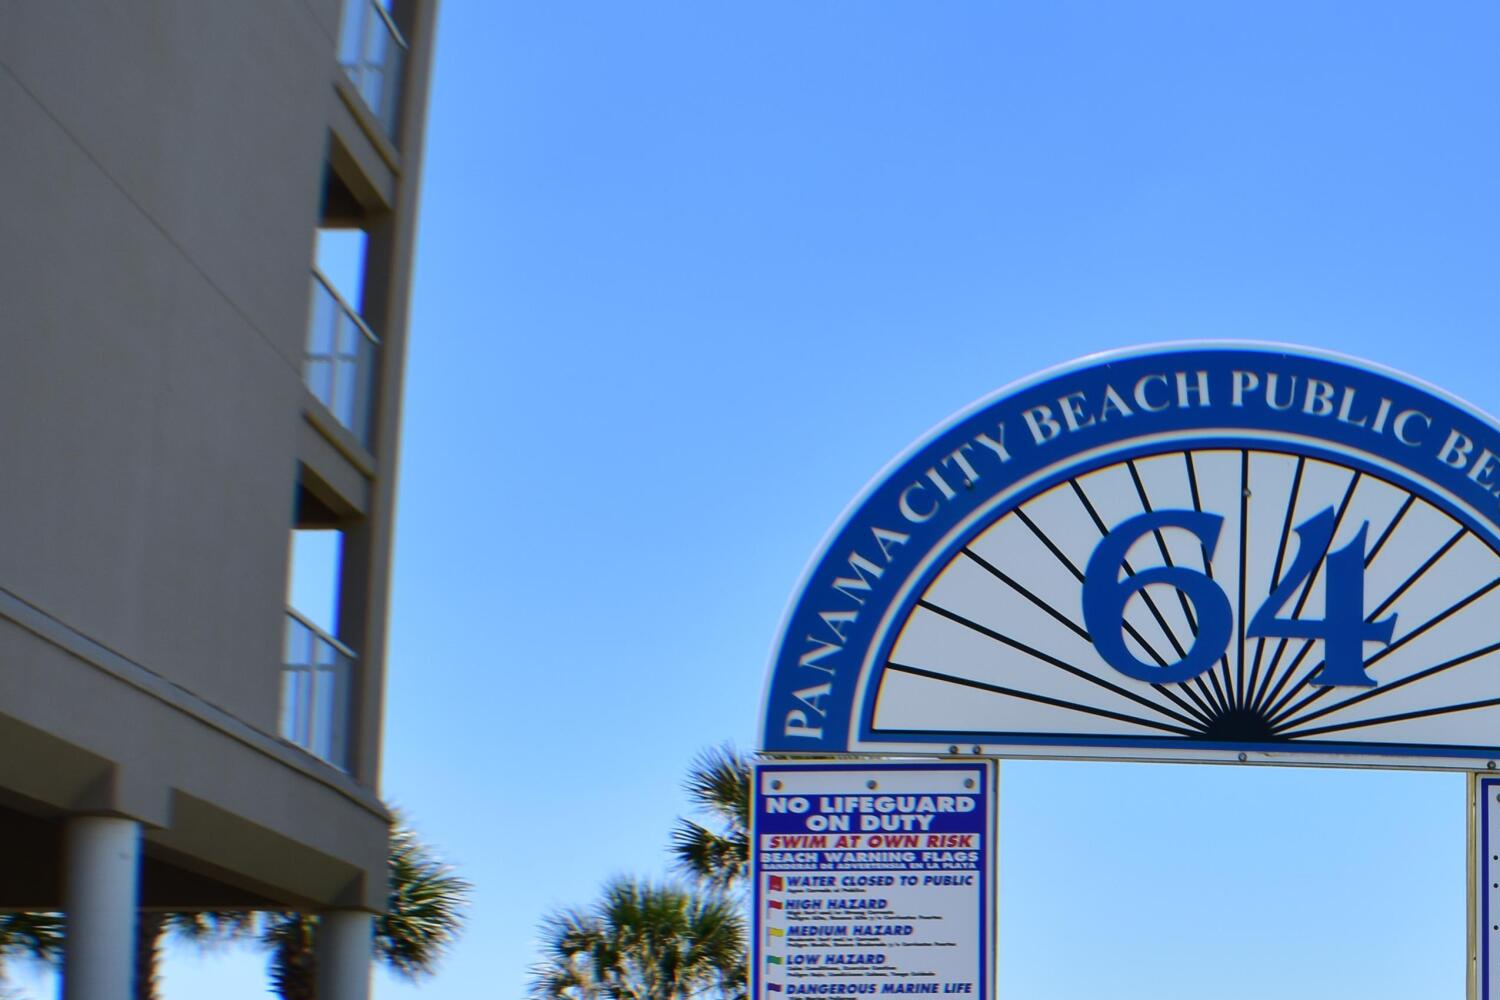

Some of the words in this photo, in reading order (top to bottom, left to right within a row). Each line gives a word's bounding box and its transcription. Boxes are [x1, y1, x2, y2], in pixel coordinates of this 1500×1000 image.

[784, 526, 910, 740] PANAMA
[898, 423, 1012, 523] CITY
[1021, 371, 1211, 446] BEACH
[1232, 370, 1432, 447] PUBLIC
[1081, 504, 1399, 687] 64
[766, 797, 810, 813] NO
[820, 796, 975, 813] LIFEGUARD
[806, 815, 850, 831] ON
[860, 815, 934, 831] DUTY
[769, 835, 826, 848] SWIM
[834, 835, 861, 848] AT
[867, 835, 919, 848] OWN
[926, 835, 972, 848] RISK
[760, 852, 818, 863] BEACH
[824, 852, 916, 862] WARNING
[922, 852, 978, 862] FLAGS
[787, 876, 836, 886] WATER
[841, 875, 894, 886] CLOSED
[900, 875, 918, 886] TO
[923, 875, 973, 886] PUBLIC
[785, 899, 822, 910] HIGH
[827, 899, 887, 909] HAZARD
[787, 925, 847, 936] MEDIUM
[853, 925, 913, 936] HAZARD
[786, 954, 820, 965] LOW
[825, 954, 885, 965] HAZARD
[786, 983, 876, 994] DANGEROUS
[881, 983, 939, 994] MARINE
[944, 982, 972, 994] LIFE
